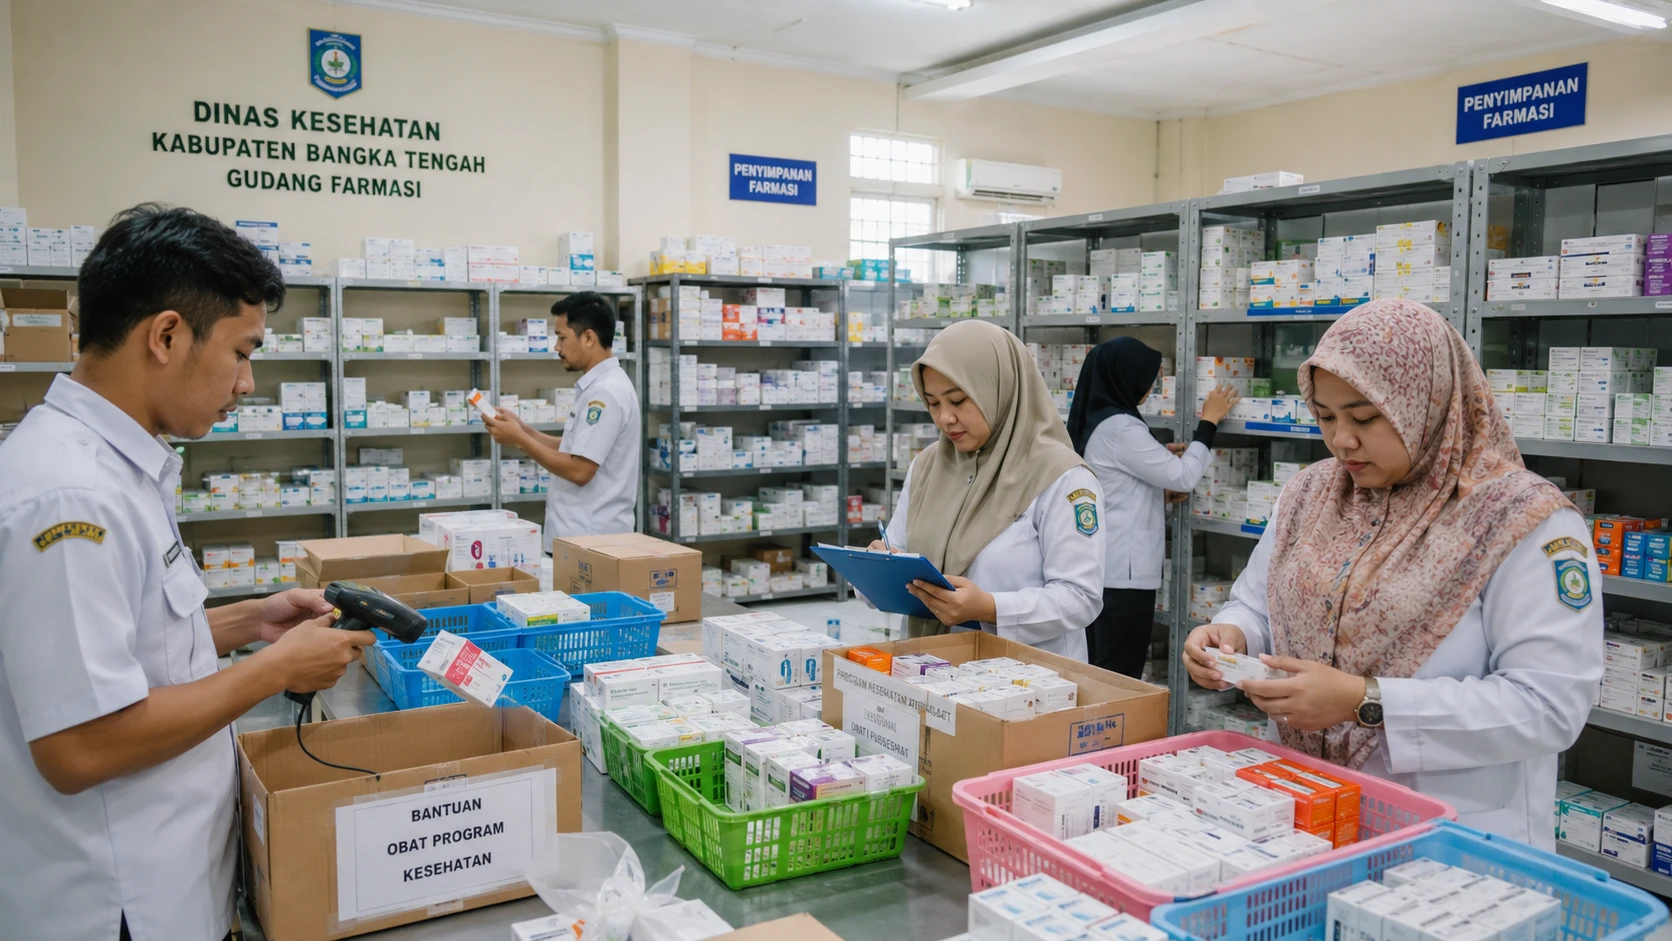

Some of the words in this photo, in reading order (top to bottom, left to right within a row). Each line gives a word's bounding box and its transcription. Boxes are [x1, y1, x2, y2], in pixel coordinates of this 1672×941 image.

[1464, 77, 1579, 113] PENYIMPANAN
[193, 100, 279, 128] DINAS
[291, 109, 441, 142] KESEHATAN
[1483, 102, 1554, 129] FARMASI
[152, 132, 296, 161] KABUPATEN
[306, 143, 397, 168] BANGKA
[405, 151, 485, 173] TENGAH
[227, 169, 322, 193] GUDANG
[331, 175, 421, 198] FARMASI
[734, 163, 812, 182] PENYIMPANAN
[749, 180, 798, 196] FARMASI
[411, 798, 482, 822] BANTUAN
[387, 837, 427, 856] OBAT
[432, 821, 504, 847] PROGRAM
[403, 852, 492, 882] KESEHATAN
